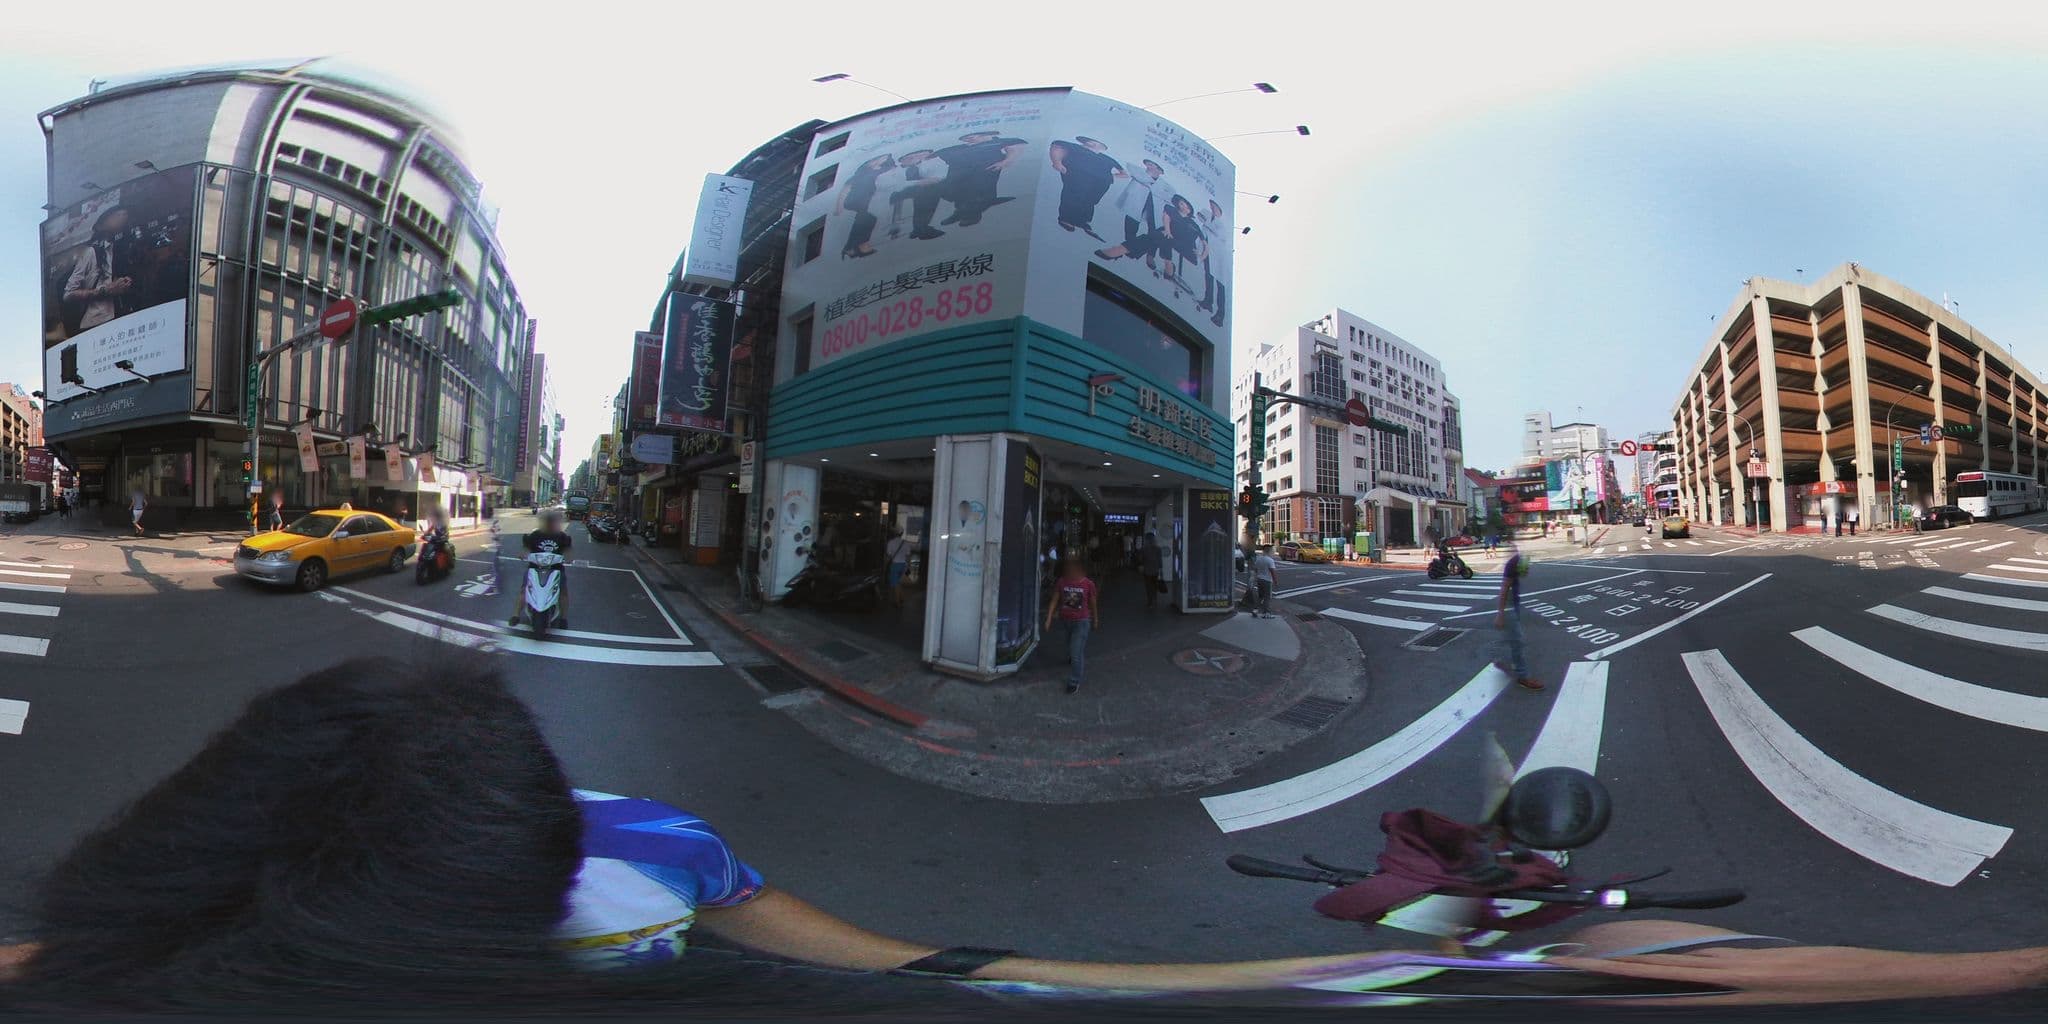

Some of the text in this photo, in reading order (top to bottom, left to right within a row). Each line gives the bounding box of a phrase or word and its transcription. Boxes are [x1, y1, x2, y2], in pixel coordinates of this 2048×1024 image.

[821, 281, 993, 358] 0800-028-858
[824, 253, 994, 321] 植髮生髮專線
